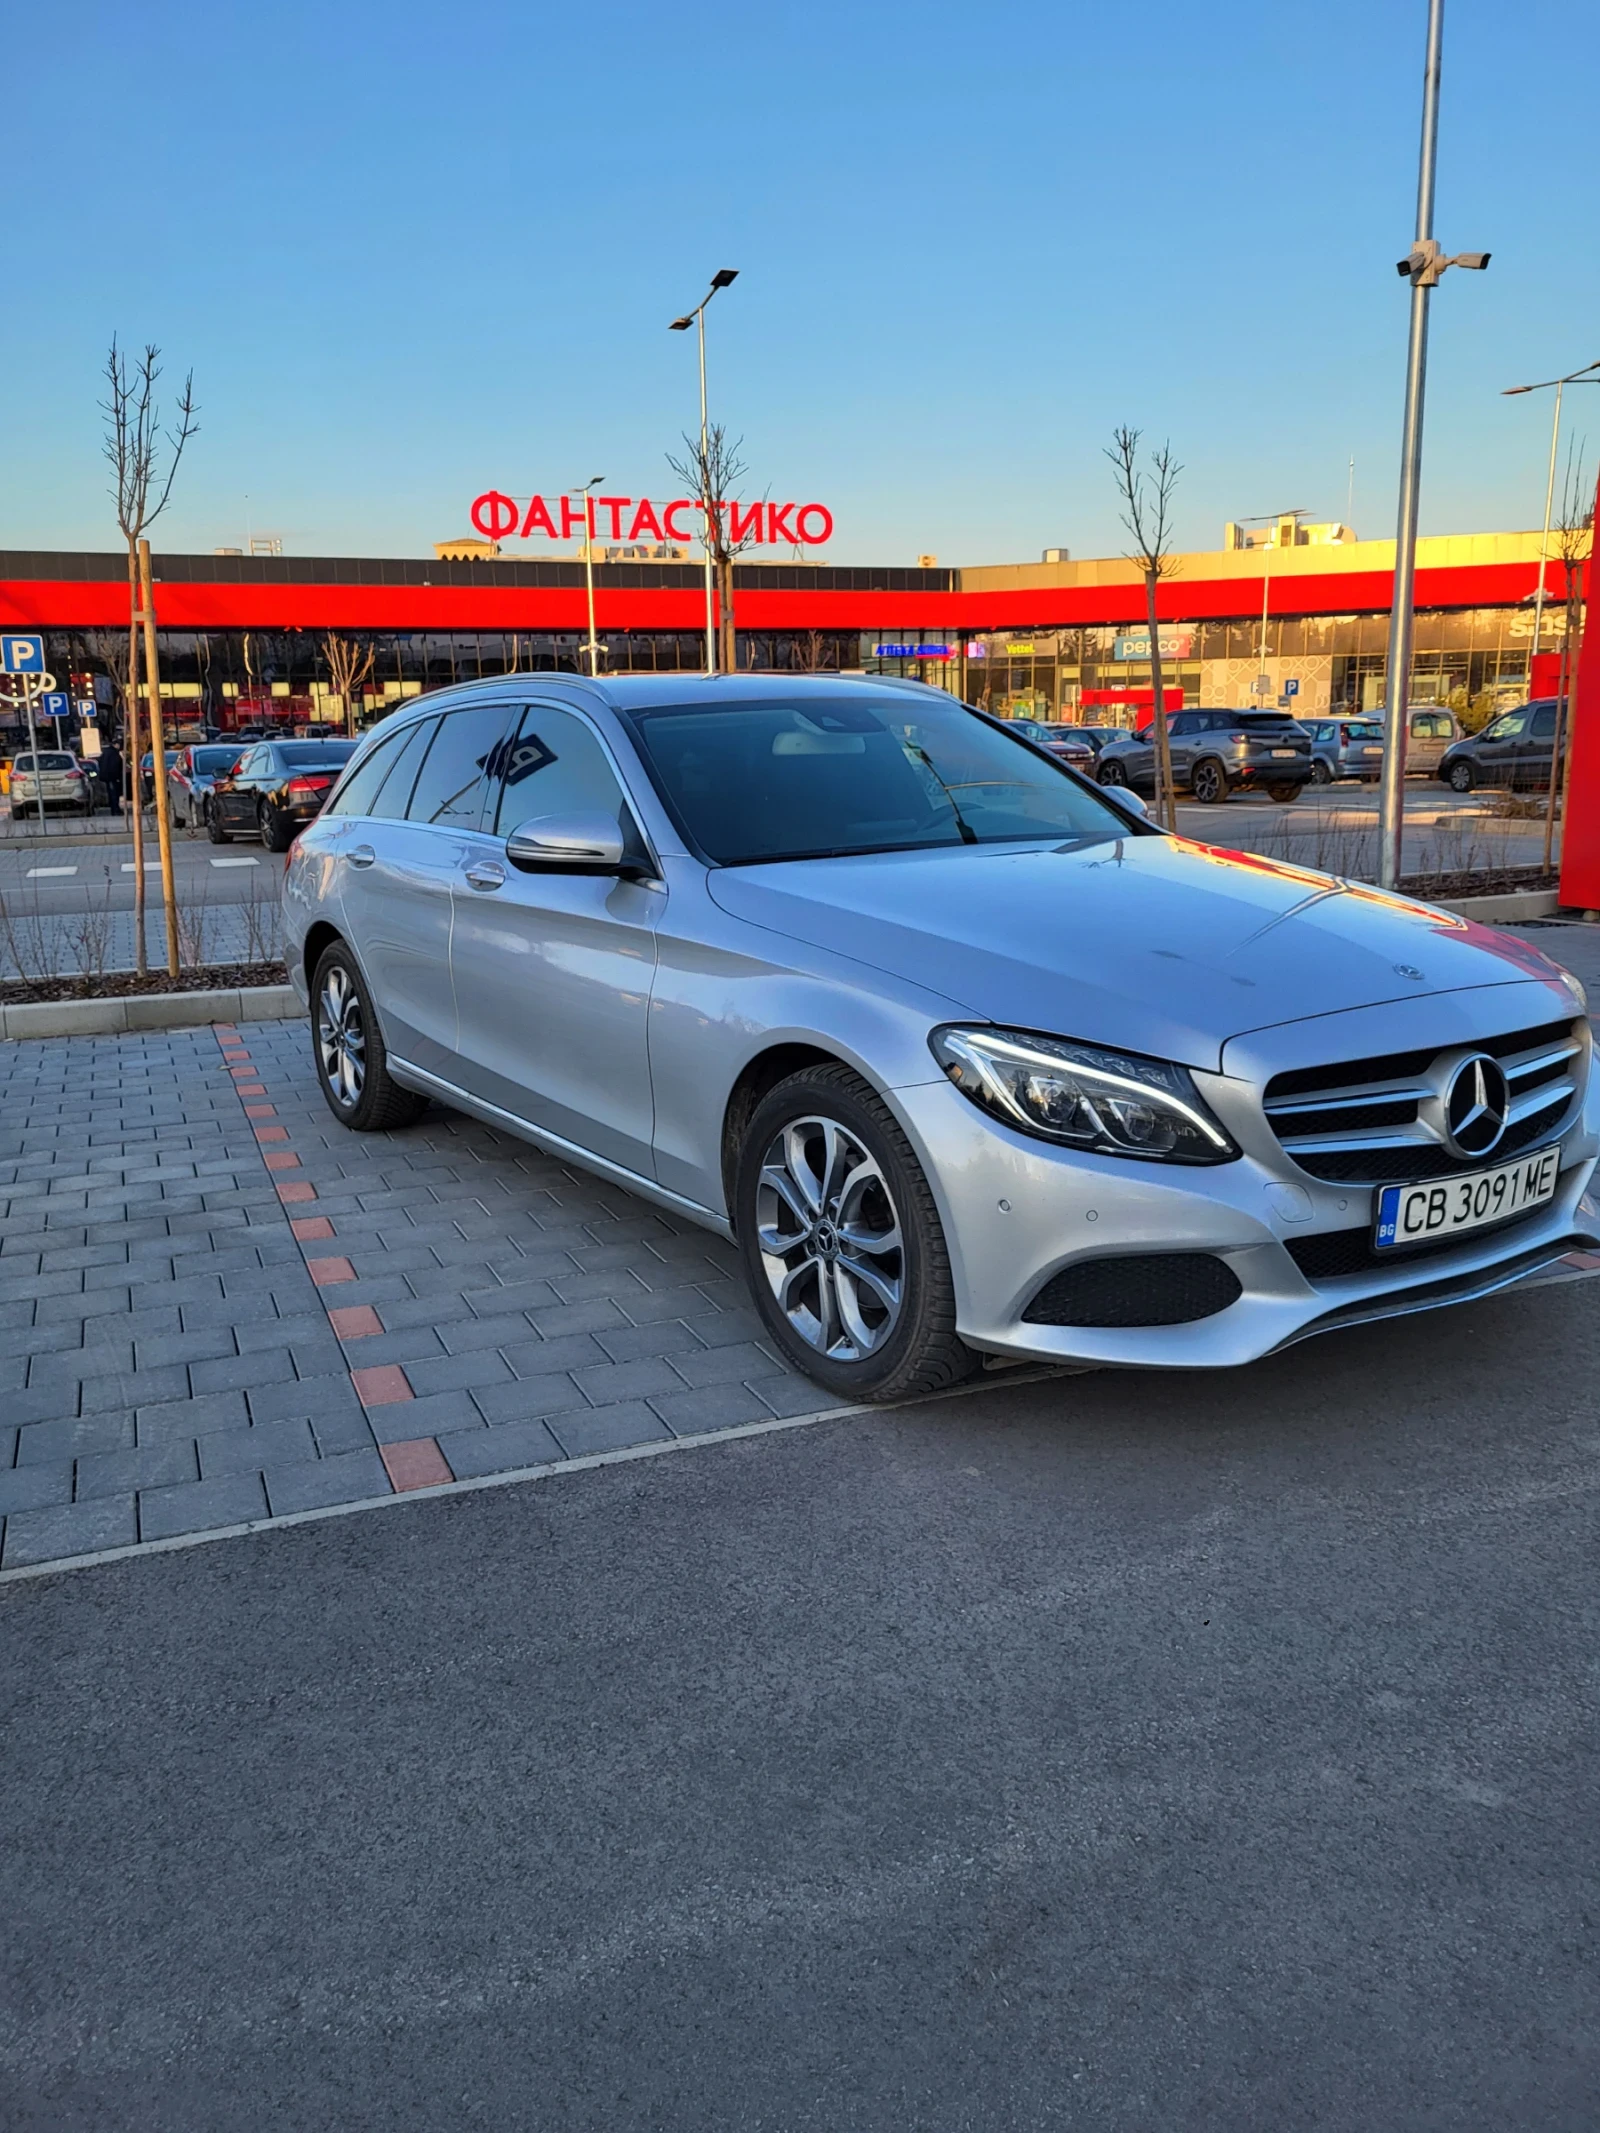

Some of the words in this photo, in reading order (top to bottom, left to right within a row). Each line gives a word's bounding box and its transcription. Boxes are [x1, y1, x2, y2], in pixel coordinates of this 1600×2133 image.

[470, 490, 834, 545] ФАНТАСТИКО
[11, 640, 35, 670] P
[1287, 681, 1297, 695] P
[48, 696, 63, 714] P
[81, 702, 93, 715] P
[1404, 1188, 1447, 1233] CB
[1453, 1167, 1521, 1224] 3091
[1523, 1154, 1556, 1203] ME
[1379, 1223, 1395, 1238] BG
